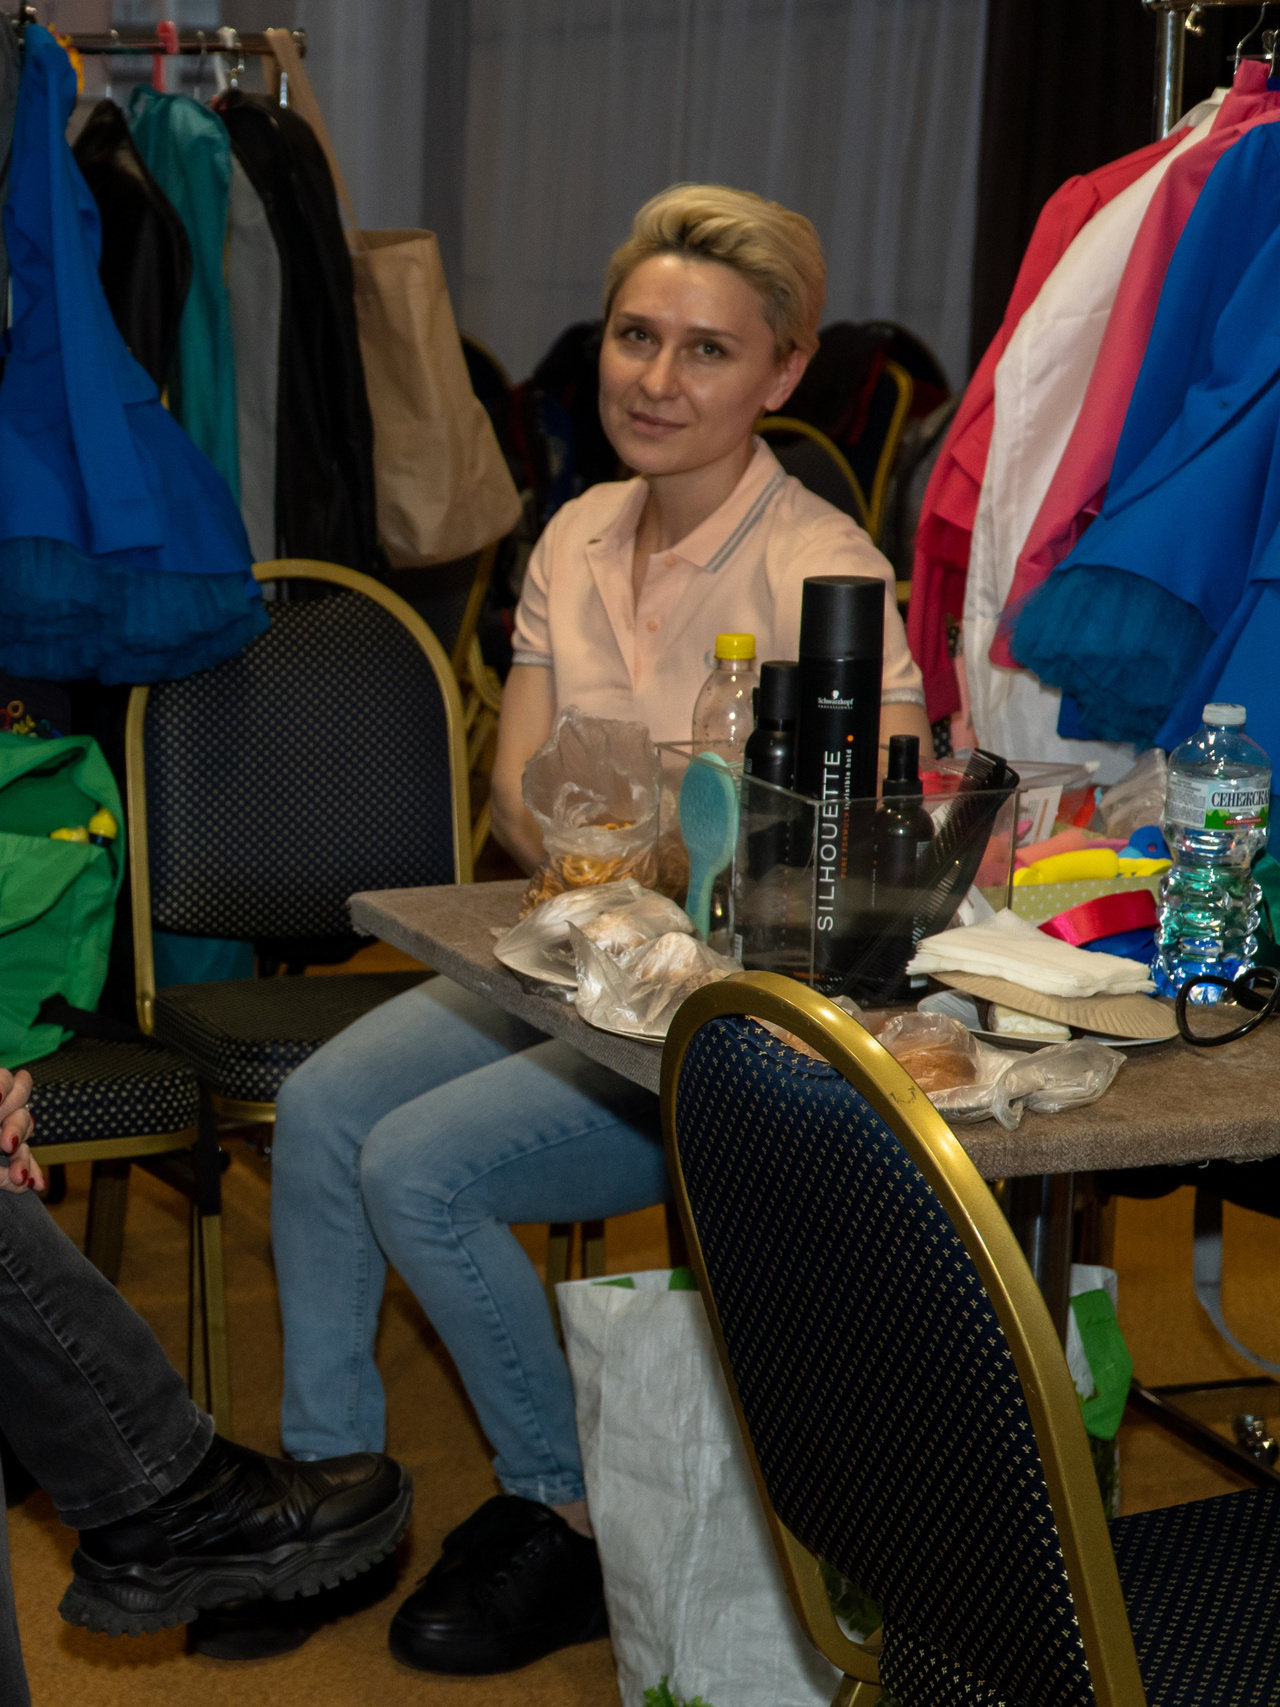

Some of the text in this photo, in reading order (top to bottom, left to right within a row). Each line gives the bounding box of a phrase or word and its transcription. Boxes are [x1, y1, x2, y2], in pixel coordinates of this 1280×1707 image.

[818, 697, 854, 706] Schwarzkopf
[817, 750, 842, 932] SILHOUETTE
[841, 812, 850, 854] FORMULA
[840, 856, 848, 879] PURE
